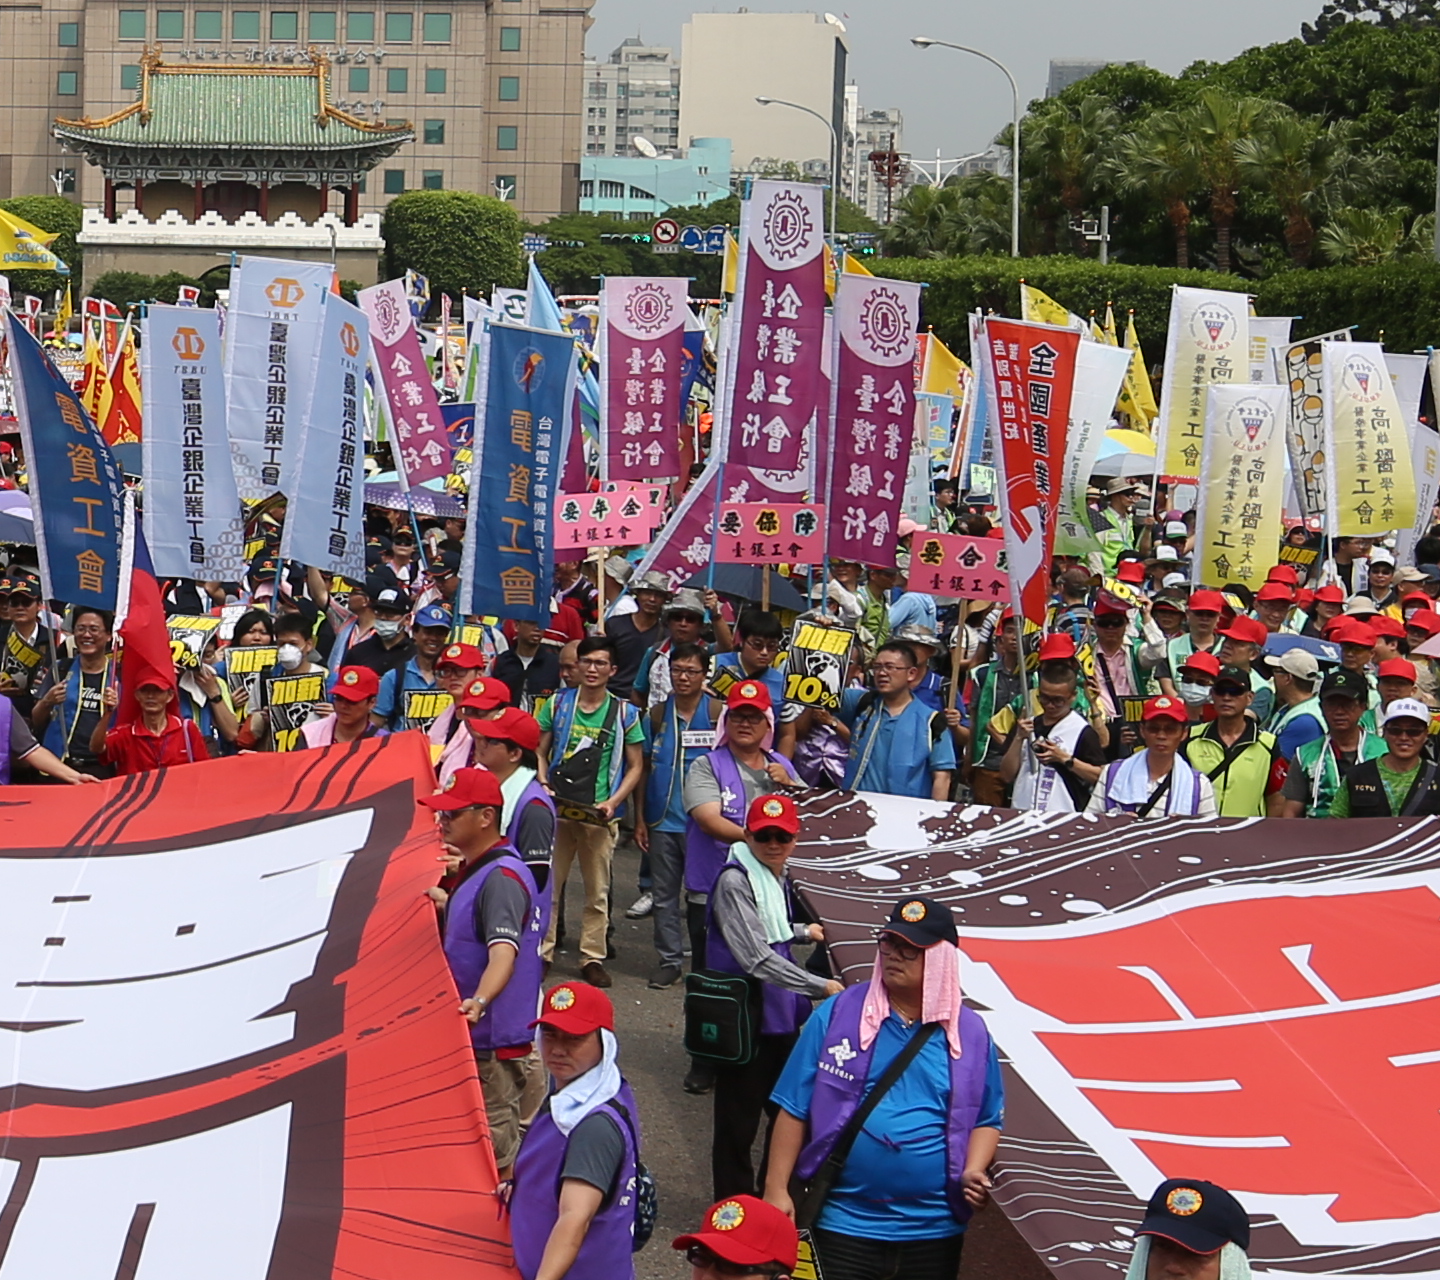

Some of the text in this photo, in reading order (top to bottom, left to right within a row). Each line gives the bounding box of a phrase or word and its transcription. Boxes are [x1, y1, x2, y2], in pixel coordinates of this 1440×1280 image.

[180, 377, 205, 564] 臺灣企銀企業工會
[328, 372, 358, 557] 臺灣企銀企業工會
[53, 391, 105, 595] 電資工會
[496, 409, 537, 607] 電資工會
[561, 491, 644, 522] 要年金
[719, 508, 818, 536] 要保障
[732, 541, 803, 558] 臺銀工會
[794, 624, 852, 656] 加薪
[272, 675, 322, 705] 加薪
[785, 675, 837, 709] 10%
